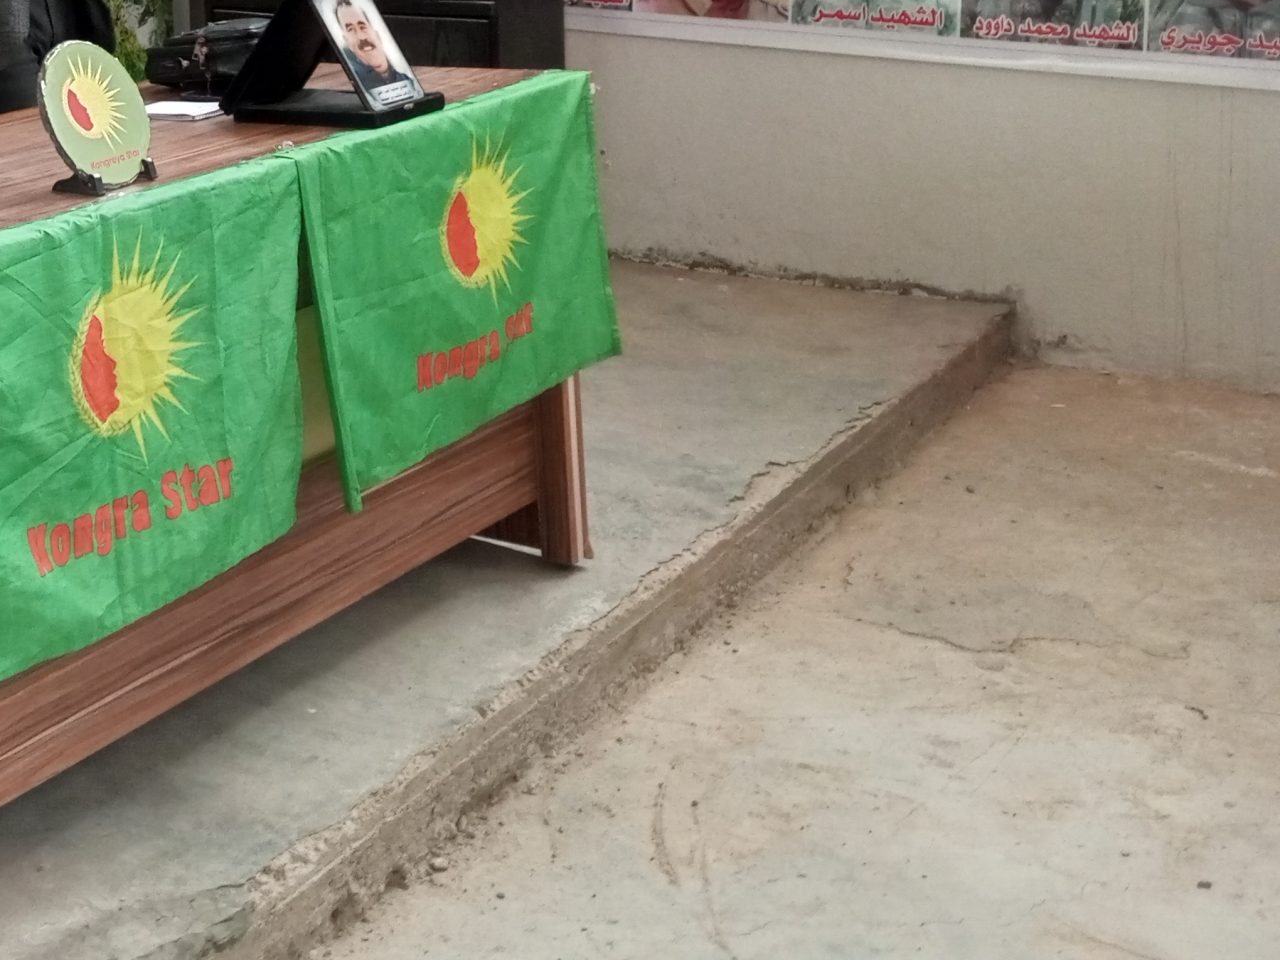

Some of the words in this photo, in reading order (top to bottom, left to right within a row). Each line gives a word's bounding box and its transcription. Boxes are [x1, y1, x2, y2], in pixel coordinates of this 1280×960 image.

[811, 3, 868, 24] اسمر
[869, 5, 945, 30] الشهيد
[973, 14, 1015, 38] داوود
[1018, 16, 1070, 37] محمد
[1074, 20, 1139, 45] الشهيد
[1159, 26, 1244, 54] جويري
[417, 329, 500, 393] Kongra
[27, 489, 152, 577] Kongra
[161, 456, 234, 520] Star
